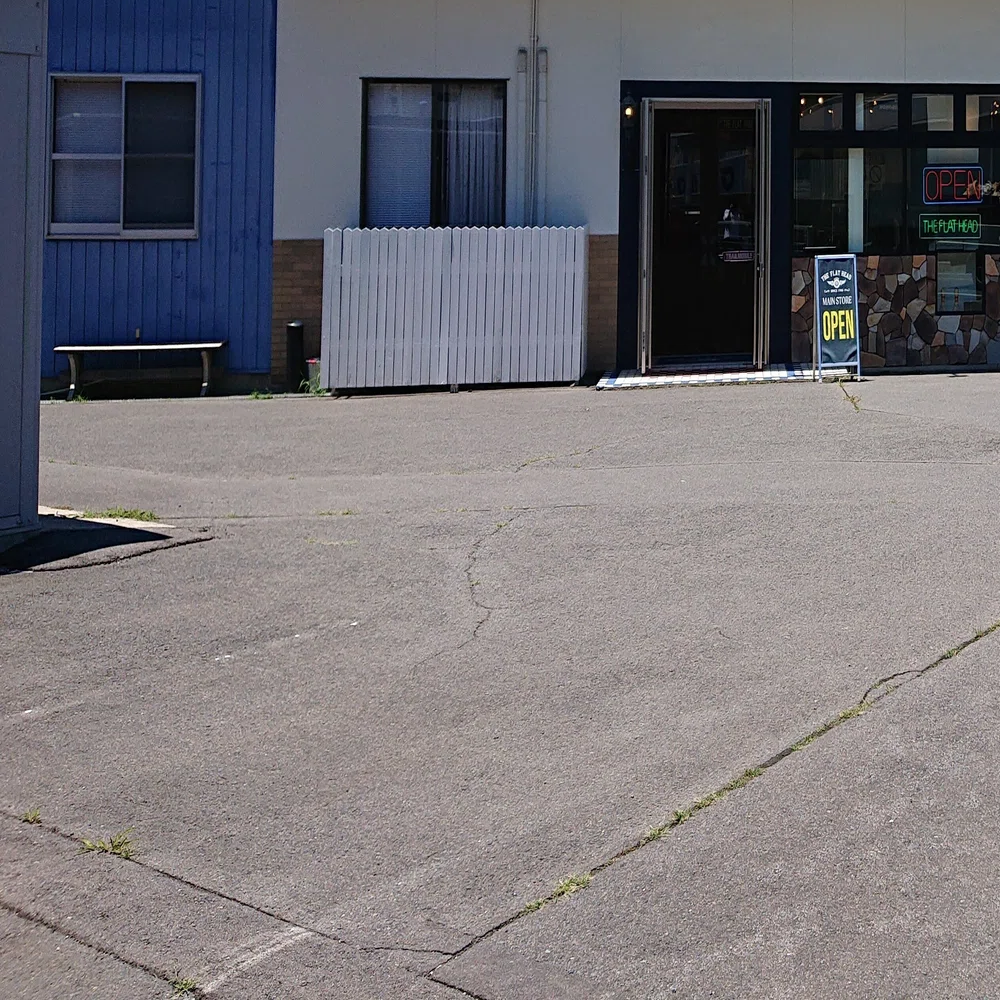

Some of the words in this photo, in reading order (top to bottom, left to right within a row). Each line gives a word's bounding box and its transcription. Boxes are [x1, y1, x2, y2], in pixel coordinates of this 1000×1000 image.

[926, 170, 981, 200] OPEN
[922, 220, 938, 233] THE
[939, 220, 956, 233] FLAT
[958, 220, 978, 233] HEAD
[822, 297, 835, 306] MAIN
[836, 295, 852, 305] STORE
[823, 310, 854, 340] OPEN
